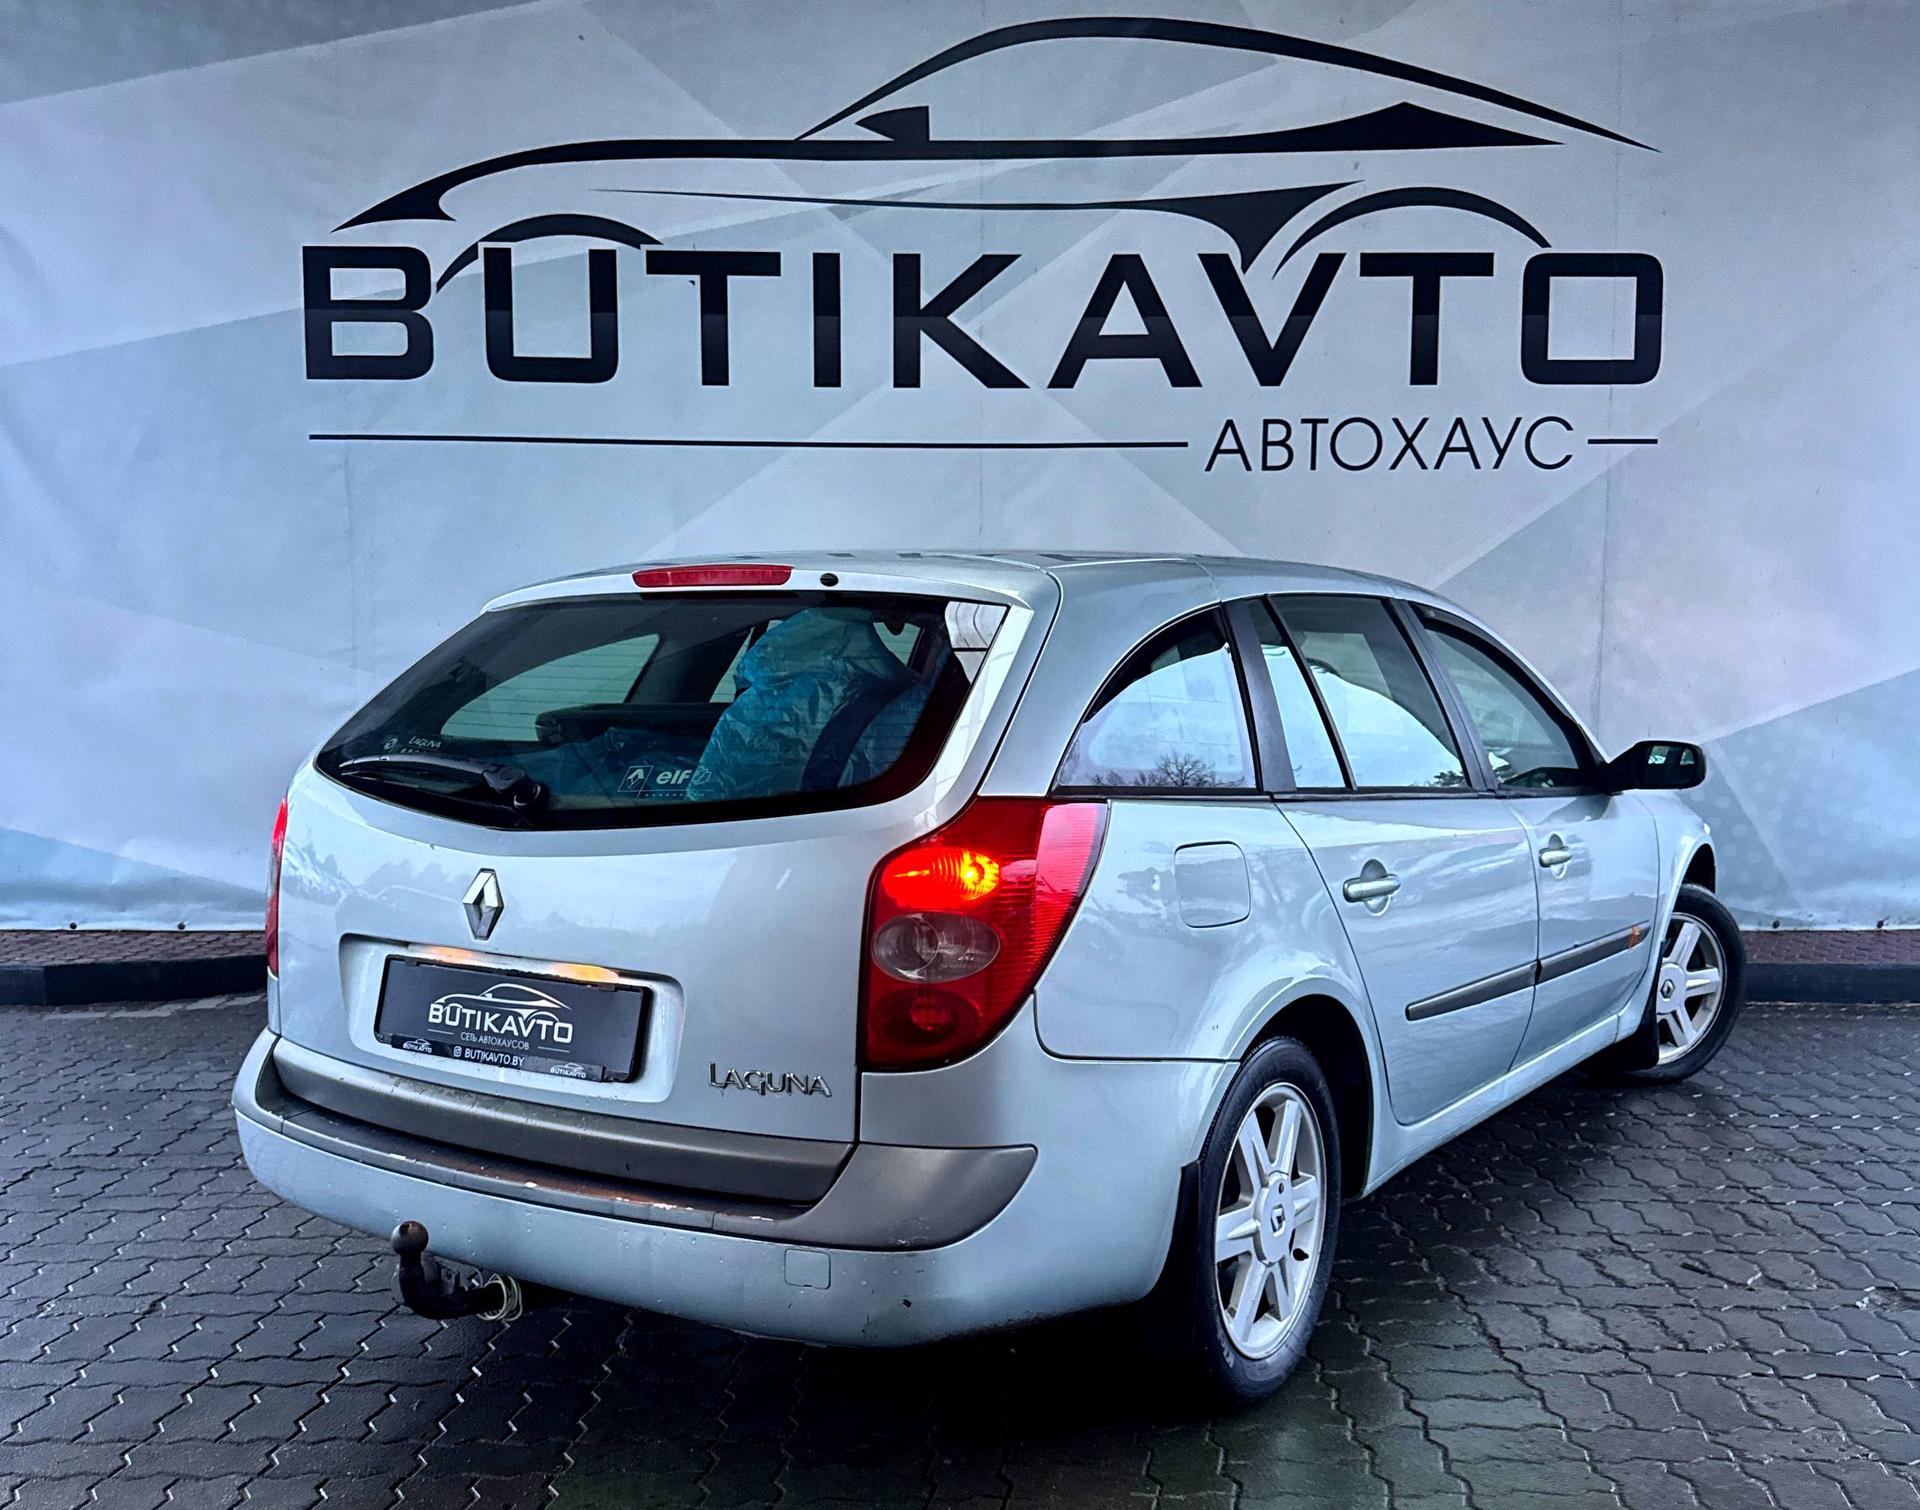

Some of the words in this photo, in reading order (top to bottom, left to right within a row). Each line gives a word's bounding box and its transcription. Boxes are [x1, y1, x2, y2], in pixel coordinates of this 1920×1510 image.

[302, 246, 1664, 389] BUTIKAVTO
[1204, 415, 1574, 472] АВТОХАУС
[656, 769, 693, 785] elf
[428, 1003, 573, 1044] BUTIKAVTO
[402, 1042, 433, 1054] BUTIKAVTO
[460, 1031, 478, 1042] СЕТЬ
[478, 1034, 530, 1050] АВТОХАУСОВ
[464, 1048, 526, 1067] BUTIKAVTO.BY
[550, 1066, 587, 1079] BUTIKAVTO
[708, 1062, 833, 1098] LAGUNA
